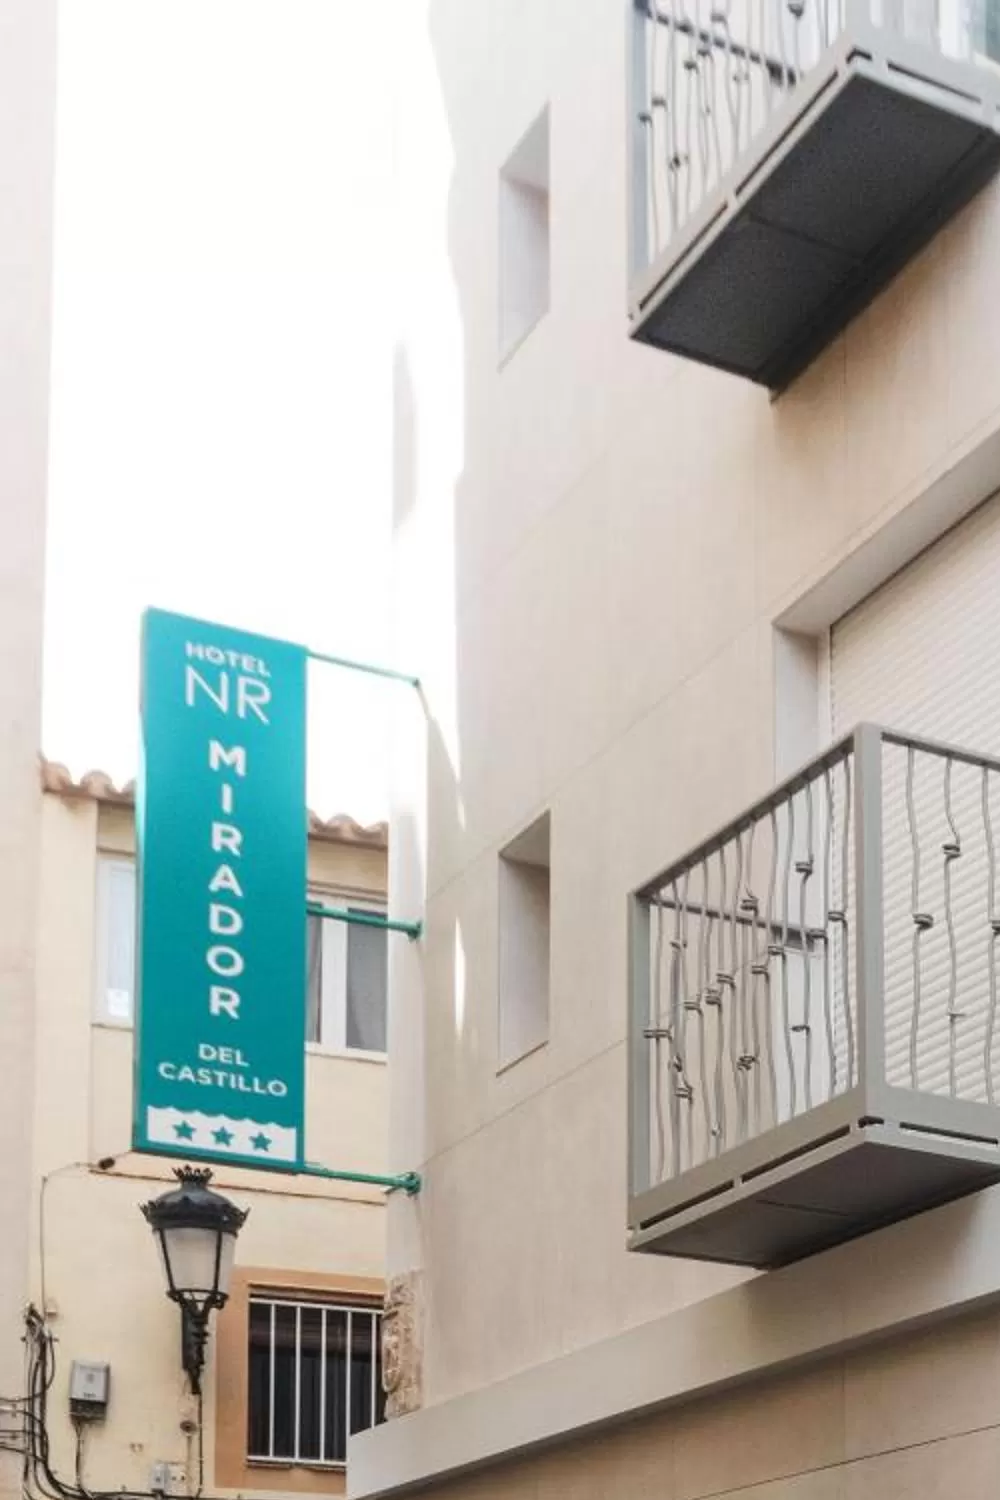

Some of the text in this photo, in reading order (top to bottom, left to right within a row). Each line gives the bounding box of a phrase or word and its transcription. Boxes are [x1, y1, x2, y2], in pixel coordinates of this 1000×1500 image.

[184, 641, 272, 678] HOTEL
[185, 663, 272, 725] NR
[206, 739, 248, 1020] MIRADOR
[198, 1042, 250, 1068] DEL
[157, 1061, 288, 1098] CASTILLO
